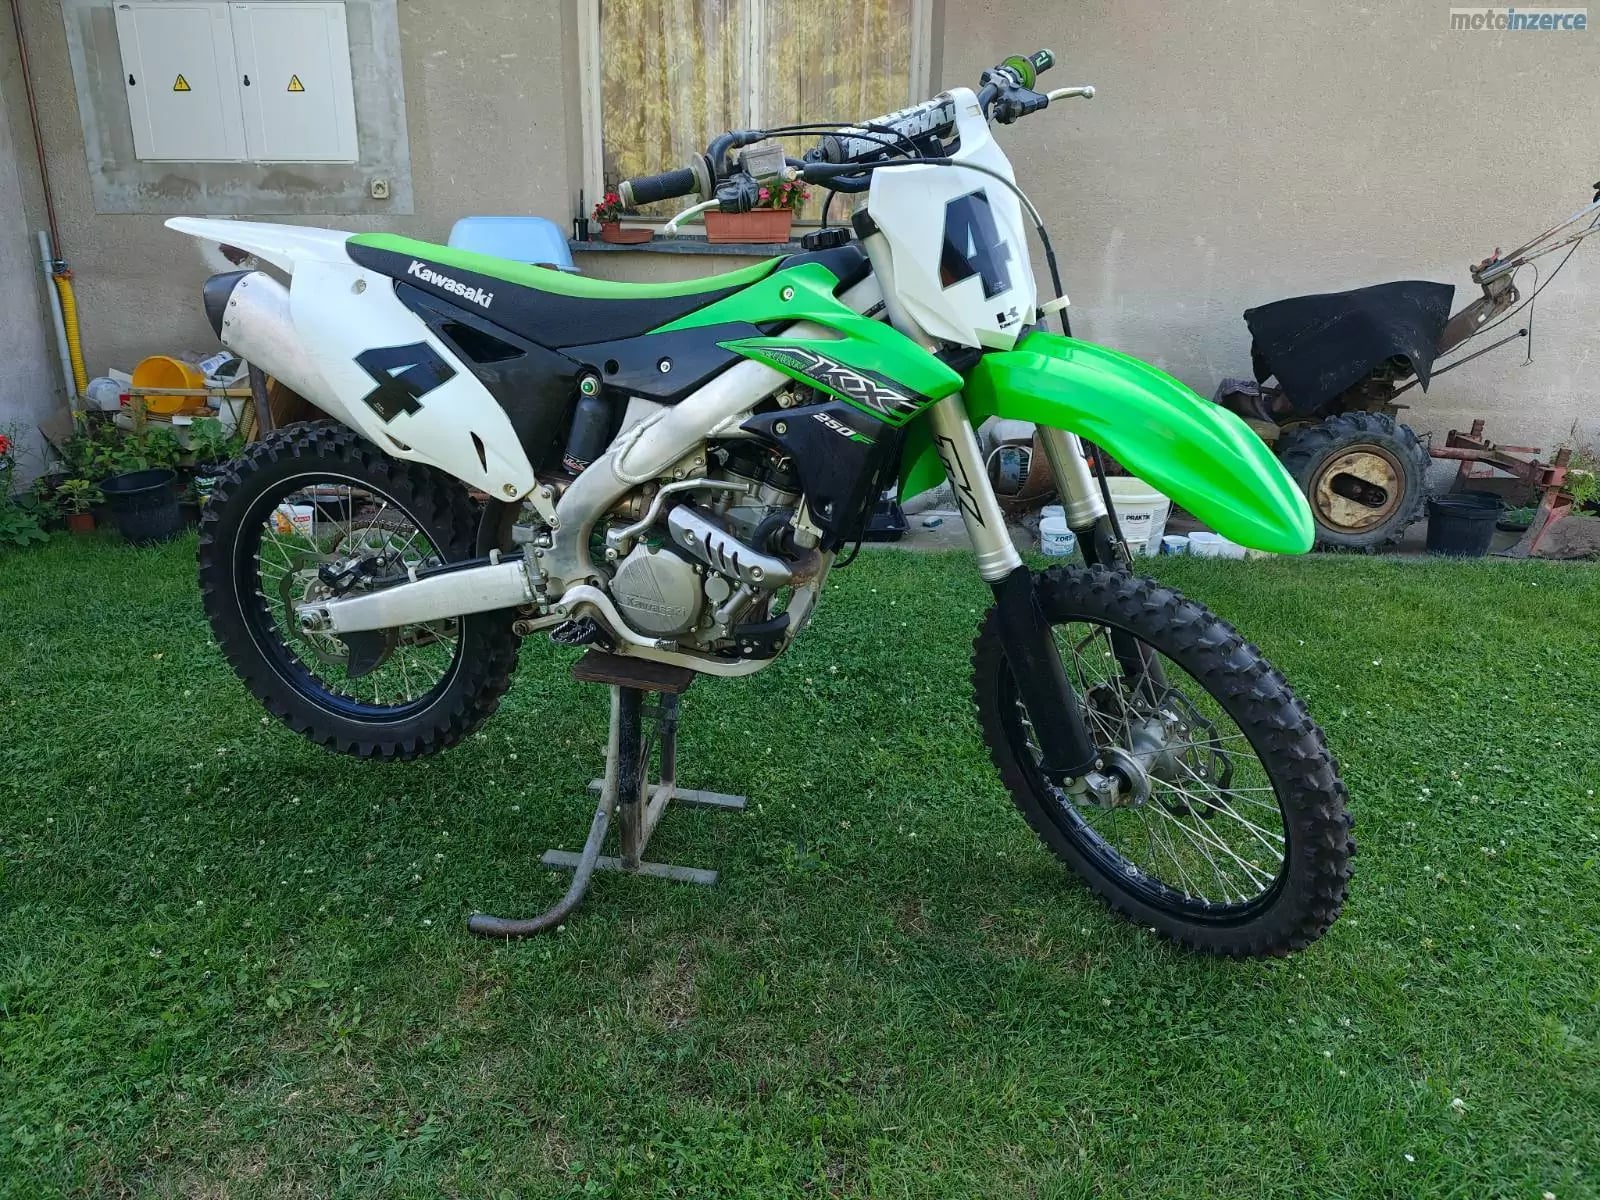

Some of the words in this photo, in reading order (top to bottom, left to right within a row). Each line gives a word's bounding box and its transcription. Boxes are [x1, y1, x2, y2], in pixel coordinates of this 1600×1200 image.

[407, 260, 494, 308] Kawasaki
[938, 187, 1013, 302] 4
[352, 339, 460, 425] 4
